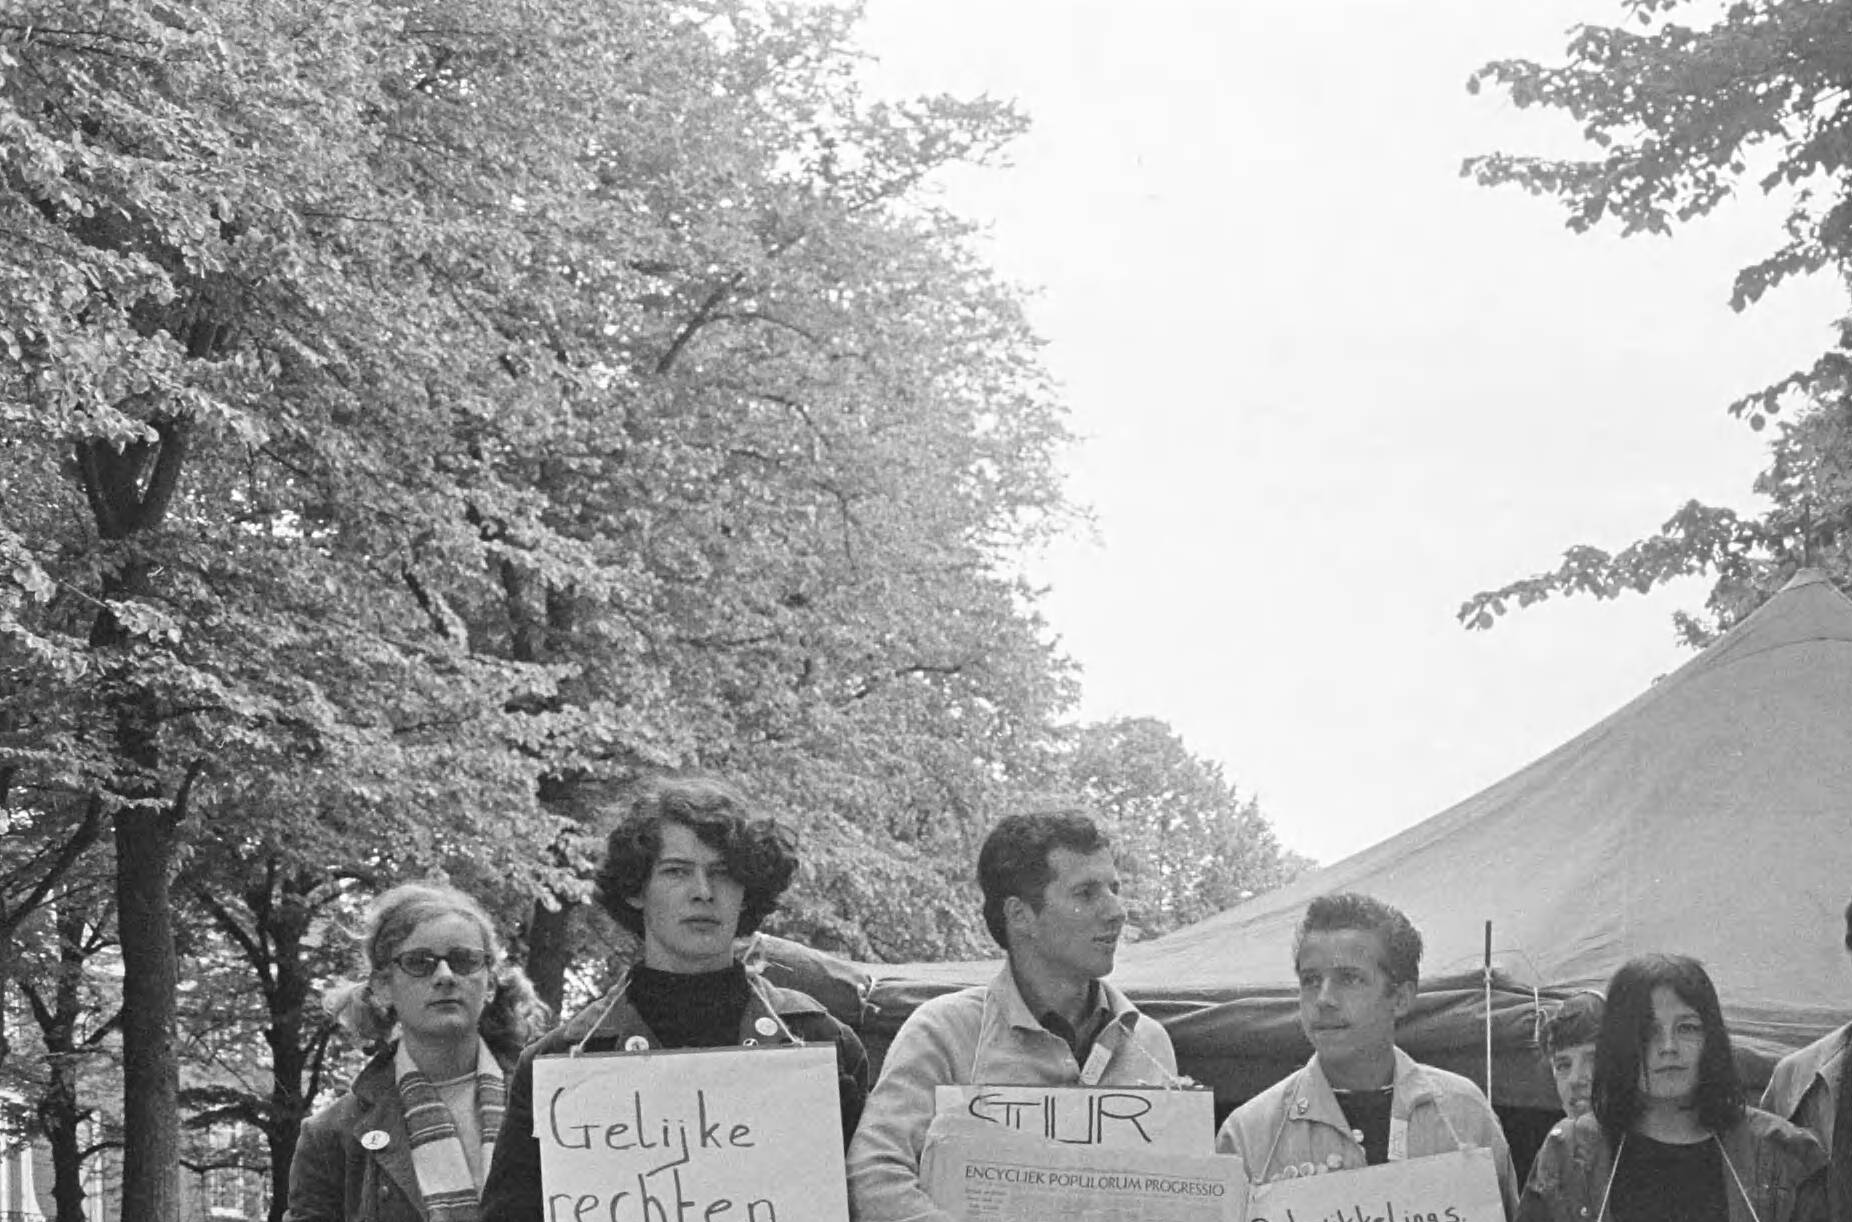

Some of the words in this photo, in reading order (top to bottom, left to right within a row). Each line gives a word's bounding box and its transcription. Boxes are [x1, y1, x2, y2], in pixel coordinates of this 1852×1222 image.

[551, 1087, 755, 1177] Gelijke
[1050, 1173, 1142, 1191] POPULORUM
[1144, 1179, 1225, 1198] PROGRESSIO
